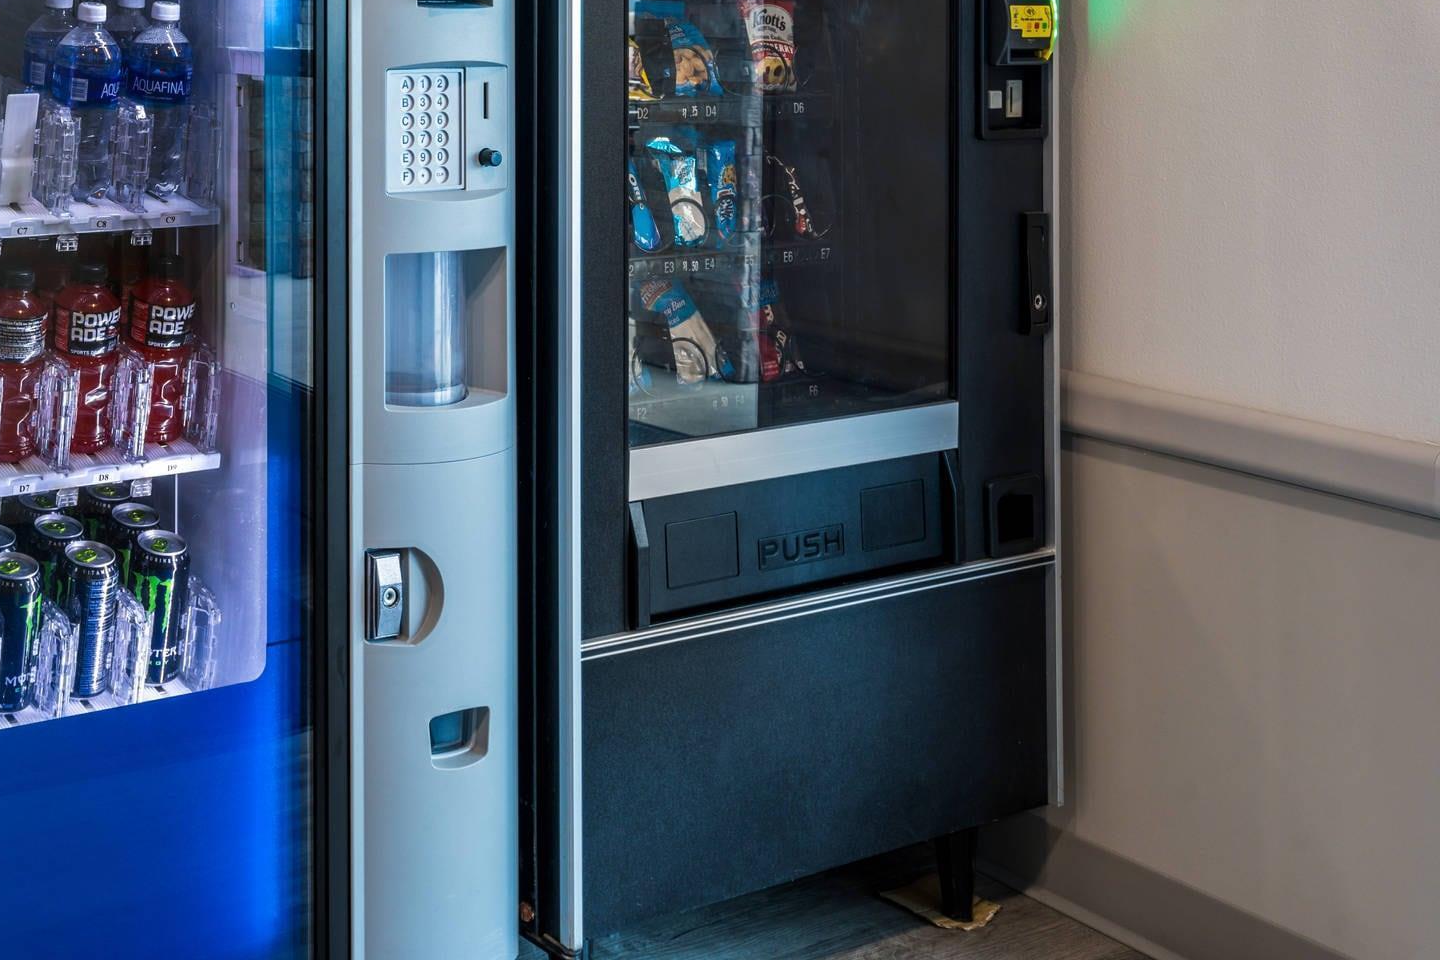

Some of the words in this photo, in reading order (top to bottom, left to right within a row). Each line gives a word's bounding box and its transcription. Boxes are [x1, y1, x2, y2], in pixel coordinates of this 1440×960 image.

[753, 8, 786, 31] Knott's
[133, 76, 185, 95] AQUAFINA
[402, 80, 409, 89] A
[421, 79, 425, 88] 1
[437, 79, 443, 88] 2
[402, 98, 409, 108] B
[420, 98, 426, 107] 3
[437, 97, 442, 106] 4
[793, 102, 804, 113] D6
[637, 108, 648, 119] D2
[705, 105, 717, 117] D4
[402, 116, 409, 126] C
[420, 116, 426, 125] 5
[437, 115, 443, 124] 6
[402, 135, 409, 144] D
[420, 134, 426, 143] 7
[437, 133, 443, 143] 8
[403, 153, 409, 162] E
[420, 152, 426, 162] 9
[437, 152, 443, 161] 0
[403, 172, 409, 181] F
[96, 220, 107, 229] C8
[165, 215, 176, 224] C9
[16, 226, 29, 236] C7
[783, 251, 794, 263] E6
[820, 248, 831, 259] E7
[705, 258, 715, 269] E4
[745, 255, 754, 265] E5
[664, 262, 675, 273] E3
[149, 322, 184, 335] ADE
[71, 327, 106, 343] ADE
[98, 472, 109, 482] D8
[19, 483, 30, 493] D7
[761, 528, 844, 567] PUSH
